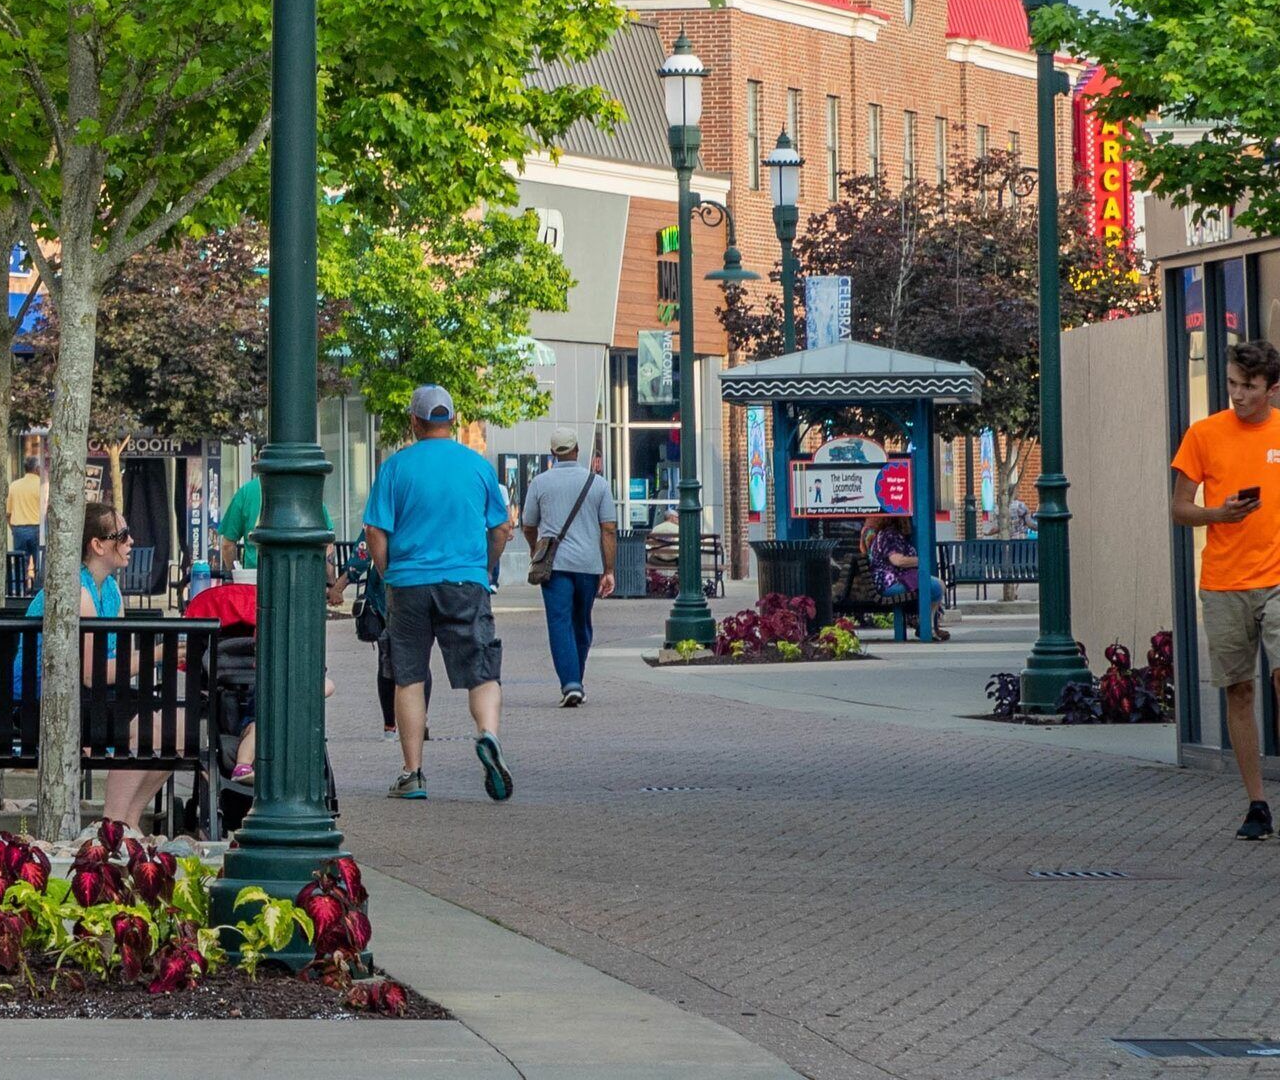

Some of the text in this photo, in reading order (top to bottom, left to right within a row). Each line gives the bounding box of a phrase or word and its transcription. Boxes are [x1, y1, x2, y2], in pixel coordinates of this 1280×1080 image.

[1101, 120, 1124, 267] ARCAD
[658, 226, 680, 253] MIR
[658, 261, 680, 300] MA
[838, 276, 852, 341] CELEBRA
[662, 331, 673, 386] WELCOME
[127, 438, 182, 452] BOOTH
[831, 473, 862, 485] The Landing
[833, 484, 862, 493] Locomotive
